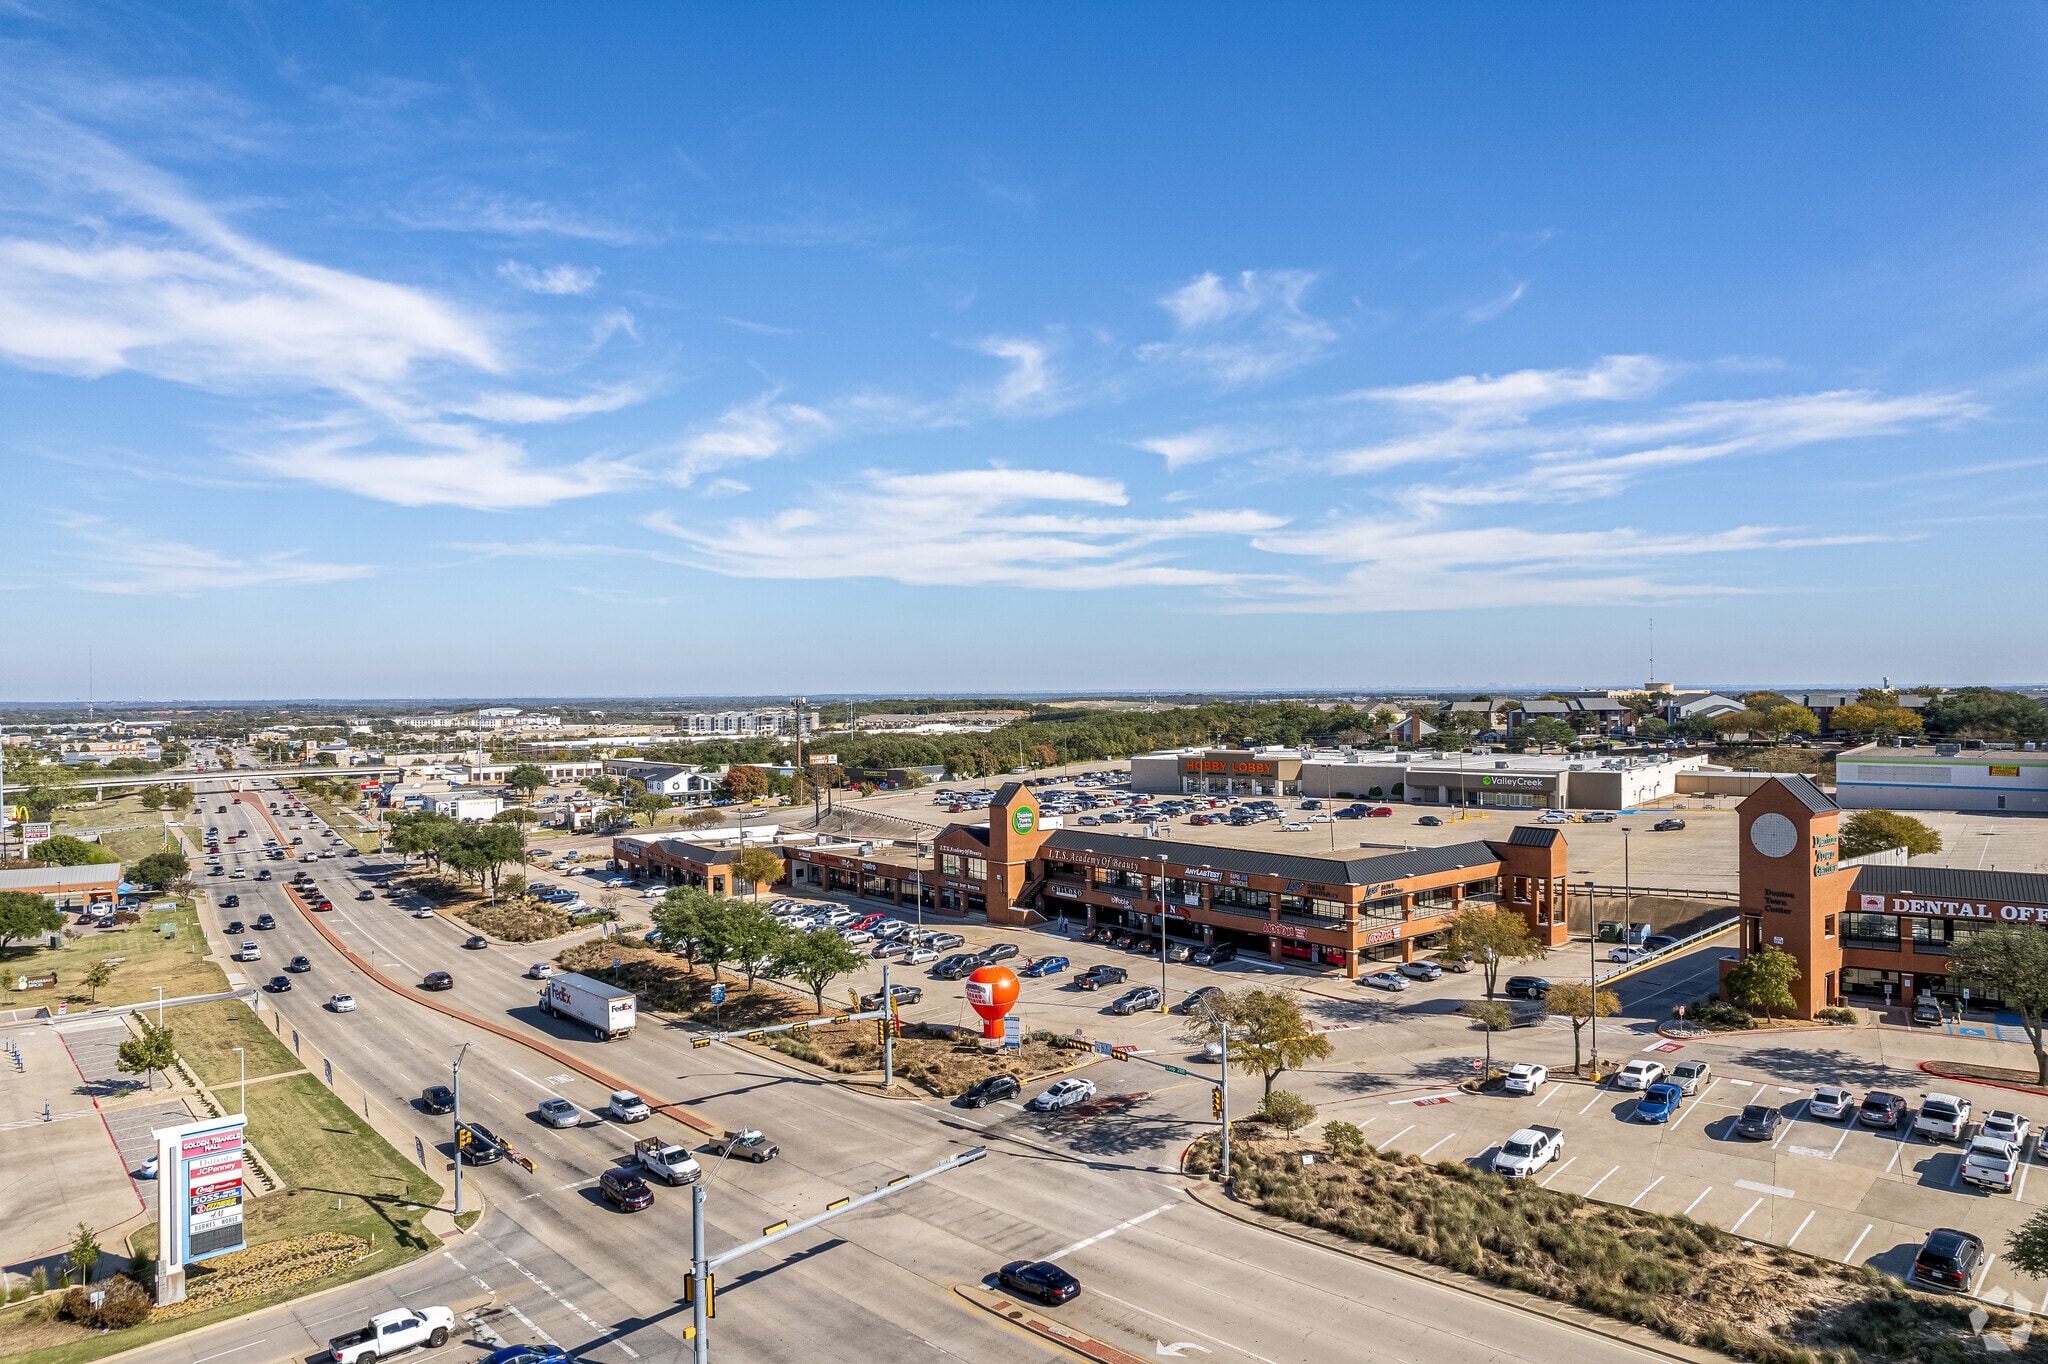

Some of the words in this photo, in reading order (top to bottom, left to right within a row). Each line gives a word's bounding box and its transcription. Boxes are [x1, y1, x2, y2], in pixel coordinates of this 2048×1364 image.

[1186, 761, 1227, 771] HOBBY
[1231, 762, 1273, 773] LOBBY
[1491, 776, 1543, 787] ValleyCreek
[1813, 834, 1837, 848] Denton
[1049, 850, 1068, 860] I.T.S.
[1070, 852, 1100, 866] Academy
[1101, 856, 1112, 868] Of
[1113, 859, 1138, 872] Beauty
[1815, 850, 1835, 861] Town
[862, 862, 877, 871] metro
[1814, 863, 1837, 876] Center
[1051, 885, 1082, 897] CHILOSO
[1307, 889, 1330, 897] STUDIO
[1765, 888, 1795, 898] Denton
[1765, 897, 1787, 906] Town
[1765, 905, 1792, 914] Center
[1892, 898, 1993, 919] DENTAL
[1263, 923, 1294, 936] MOOYAH
[1367, 928, 1393, 944] MOOYAH
[552, 983, 571, 1005] FedEx
[611, 1003, 633, 1013] FedEx
[183, 1138, 210, 1150] GOLDEN
[211, 1132, 241, 1144] TRIANGLE
[204, 1143, 222, 1153] MALL
[197, 1162, 236, 1176] JCPenney
[193, 1193, 220, 1205] ROSS
[194, 1221, 216, 1232] BARNES
[221, 1215, 238, 1226] NOBLE
